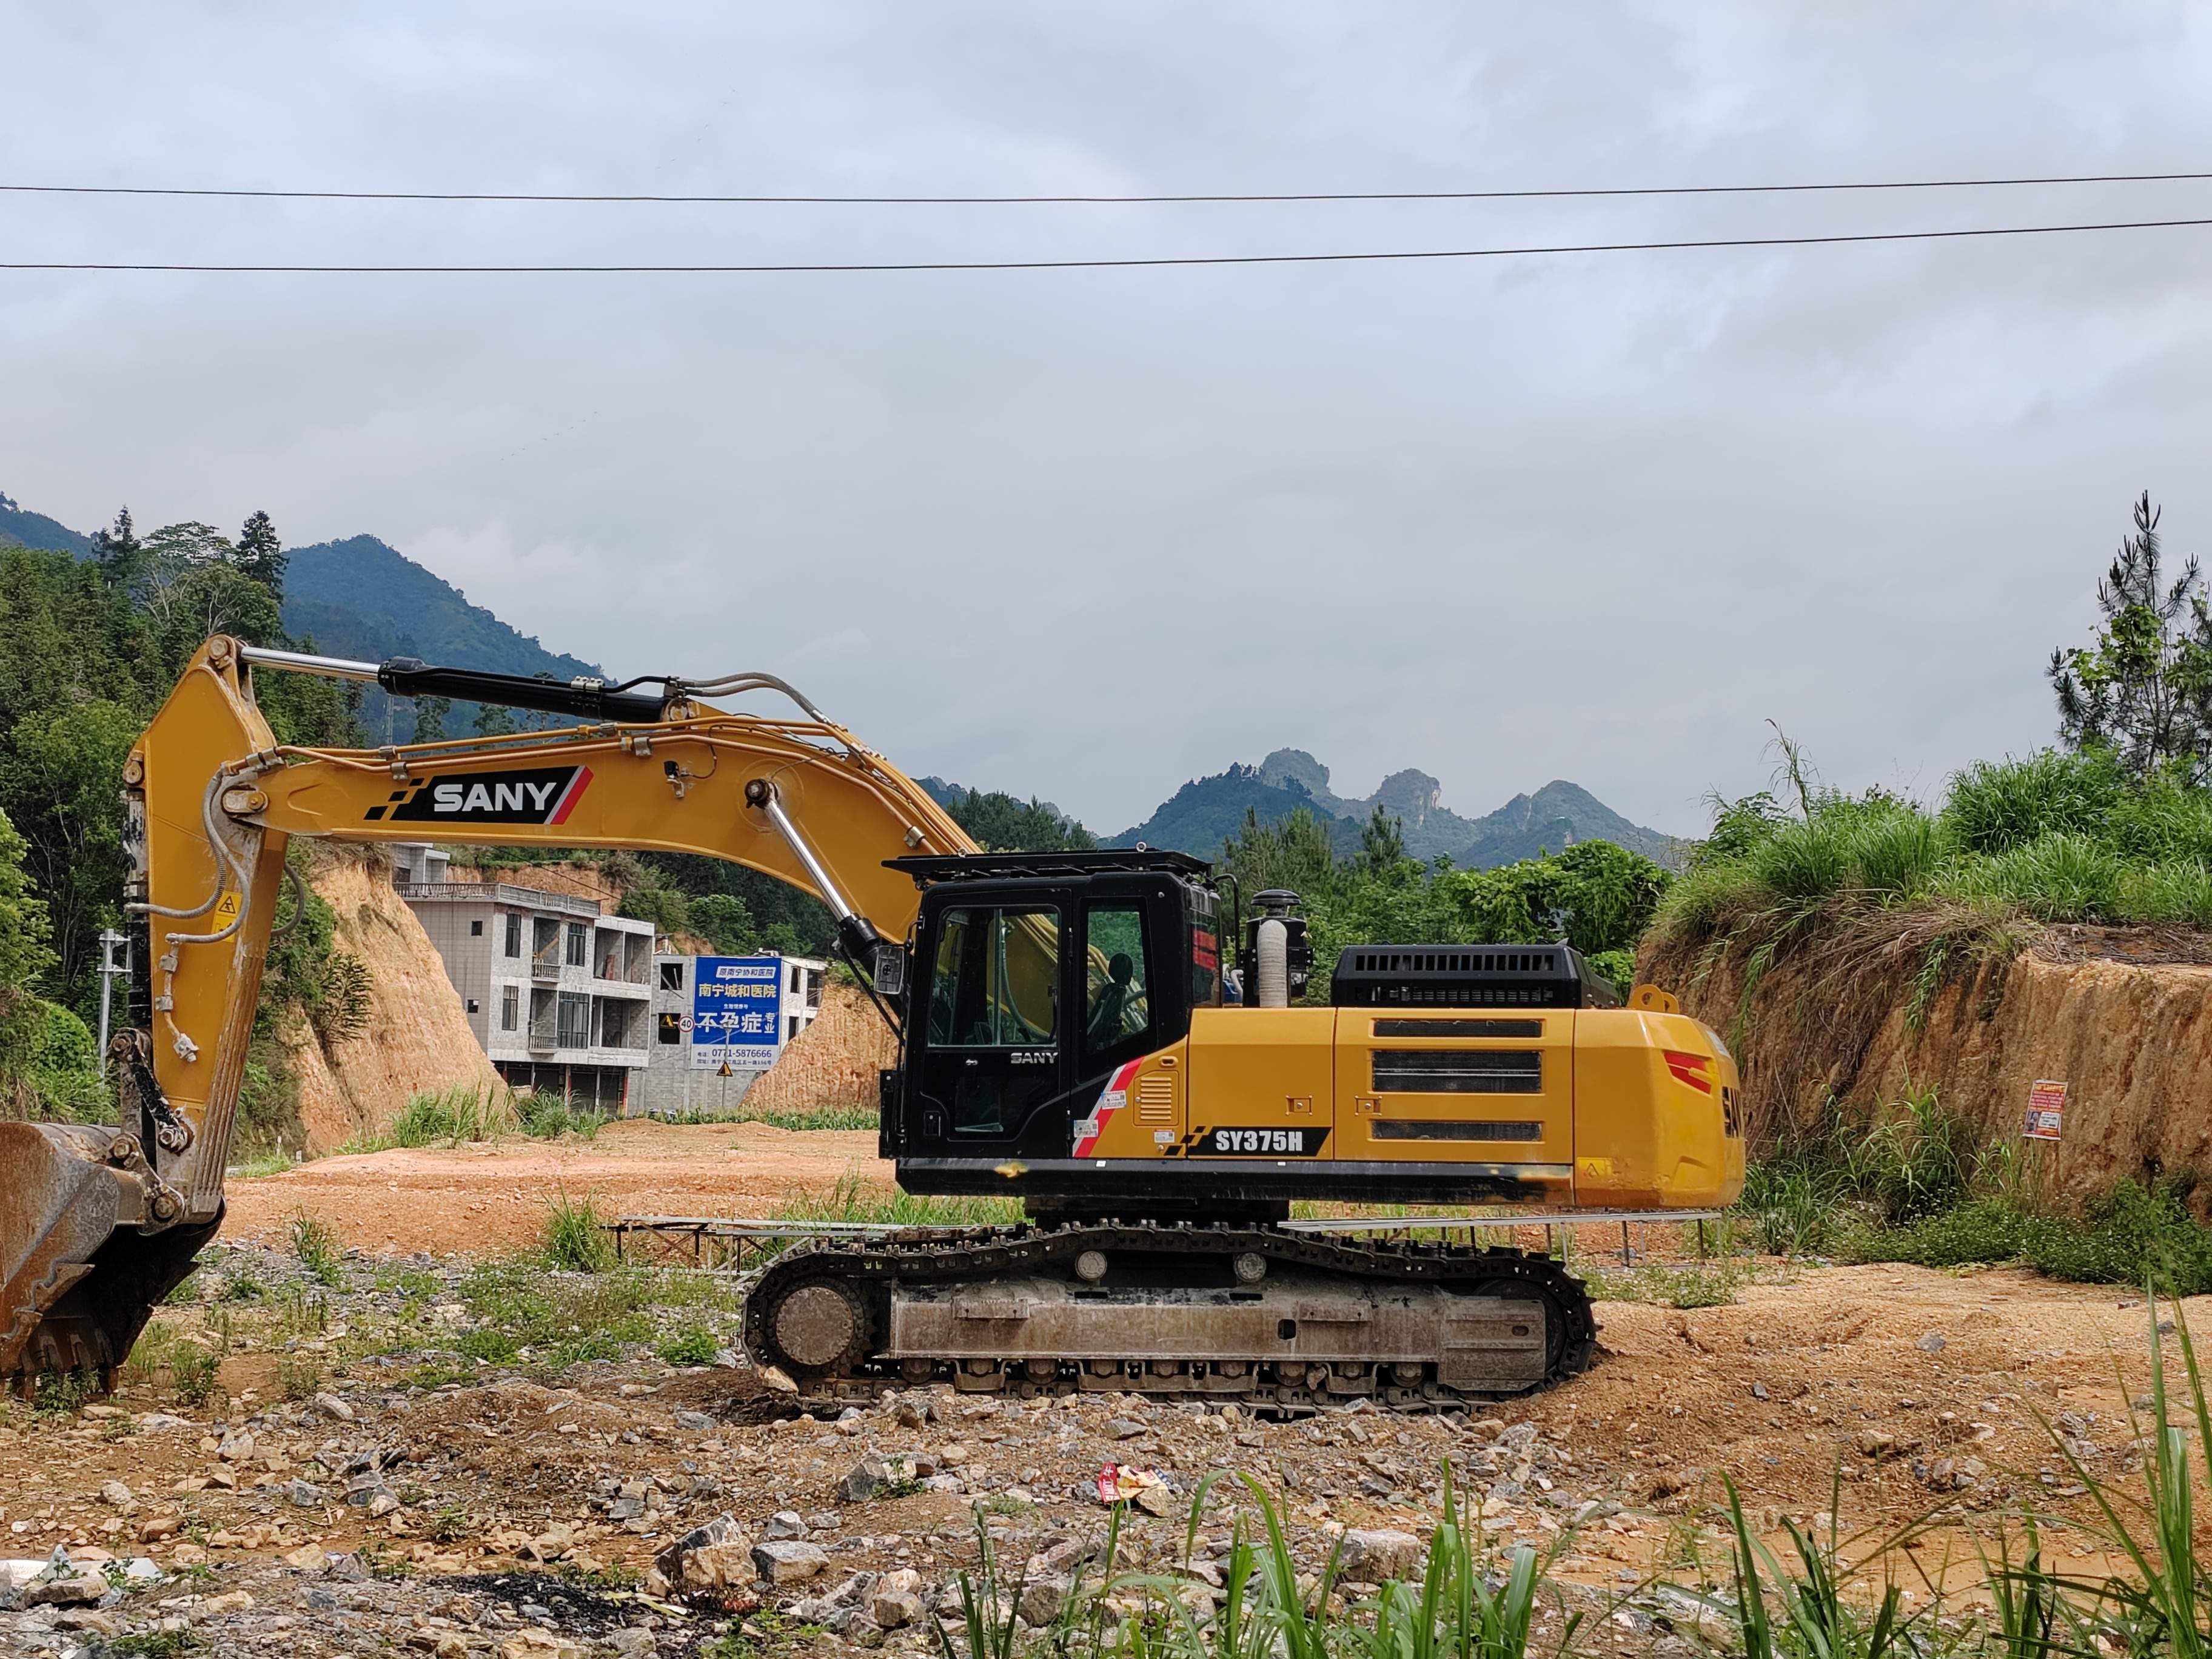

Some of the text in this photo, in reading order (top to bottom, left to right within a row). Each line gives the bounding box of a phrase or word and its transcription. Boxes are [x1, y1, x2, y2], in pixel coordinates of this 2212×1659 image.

[434, 782, 557, 812] SANY
[699, 983, 777, 998] 南宁城和医院
[682, 1020, 691, 1028] 40
[698, 1011, 762, 1033] 不孕症
[712, 1048, 772, 1058] 0771-5876666
[1011, 1053, 1058, 1064] SANY
[1216, 1131, 1302, 1151] SY375H
